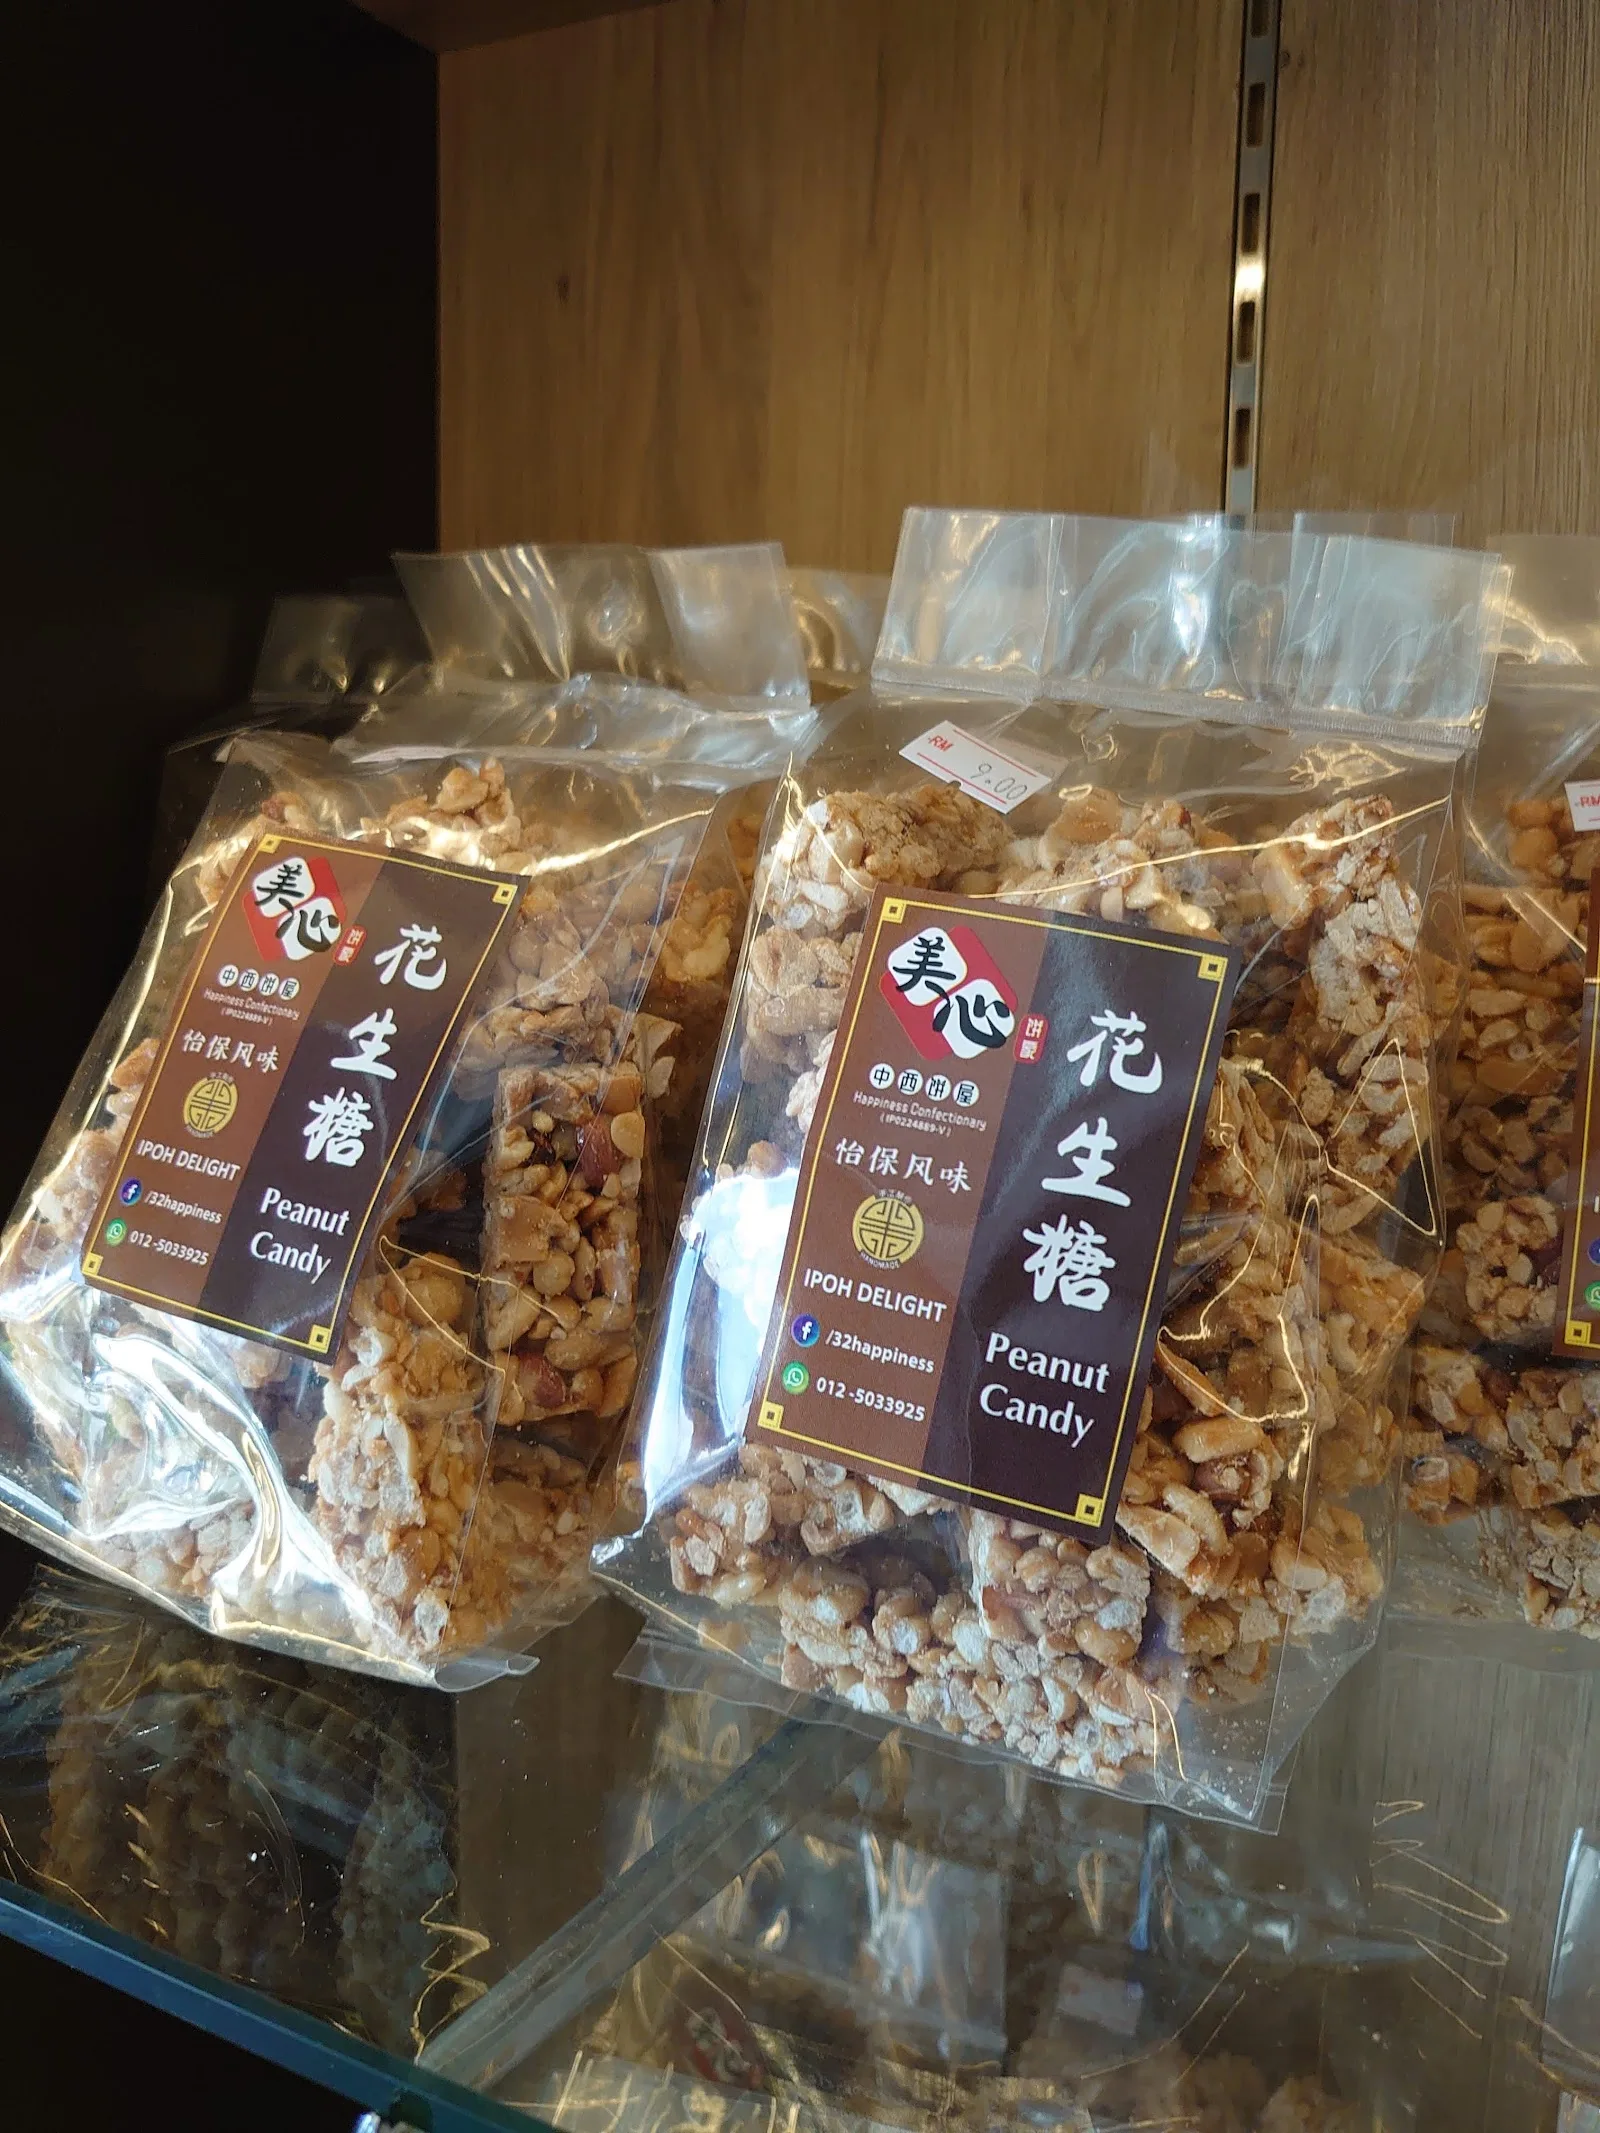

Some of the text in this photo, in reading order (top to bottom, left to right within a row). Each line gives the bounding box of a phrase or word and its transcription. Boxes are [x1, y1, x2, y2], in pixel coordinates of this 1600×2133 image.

[929, 735, 1028, 800] RM 9.00
[255, 864, 341, 952] 美心
[222, 968, 297, 998] 中西饼屋
[893, 936, 1010, 1049] 美心
[182, 1029, 279, 1073] 怡保风味
[303, 924, 447, 1167] 花生糖
[853, 1091, 987, 1132] Happiness Confectionary
[874, 1067, 975, 1105] 中西饼屋
[137, 1139, 241, 1181] IPOH DELIGHT
[836, 1138, 972, 1194] 怡保风味
[1022, 1009, 1163, 1312] 花生糖
[144, 1190, 222, 1224] /32happiness
[260, 1187, 350, 1236] Peanut
[250, 1231, 331, 1284] Candy
[804, 1268, 947, 1323] IPOH DELIGHT
[825, 1329, 935, 1373] /32happiness
[985, 1331, 1110, 1393] Peanut
[980, 1383, 1094, 1448] Candy
